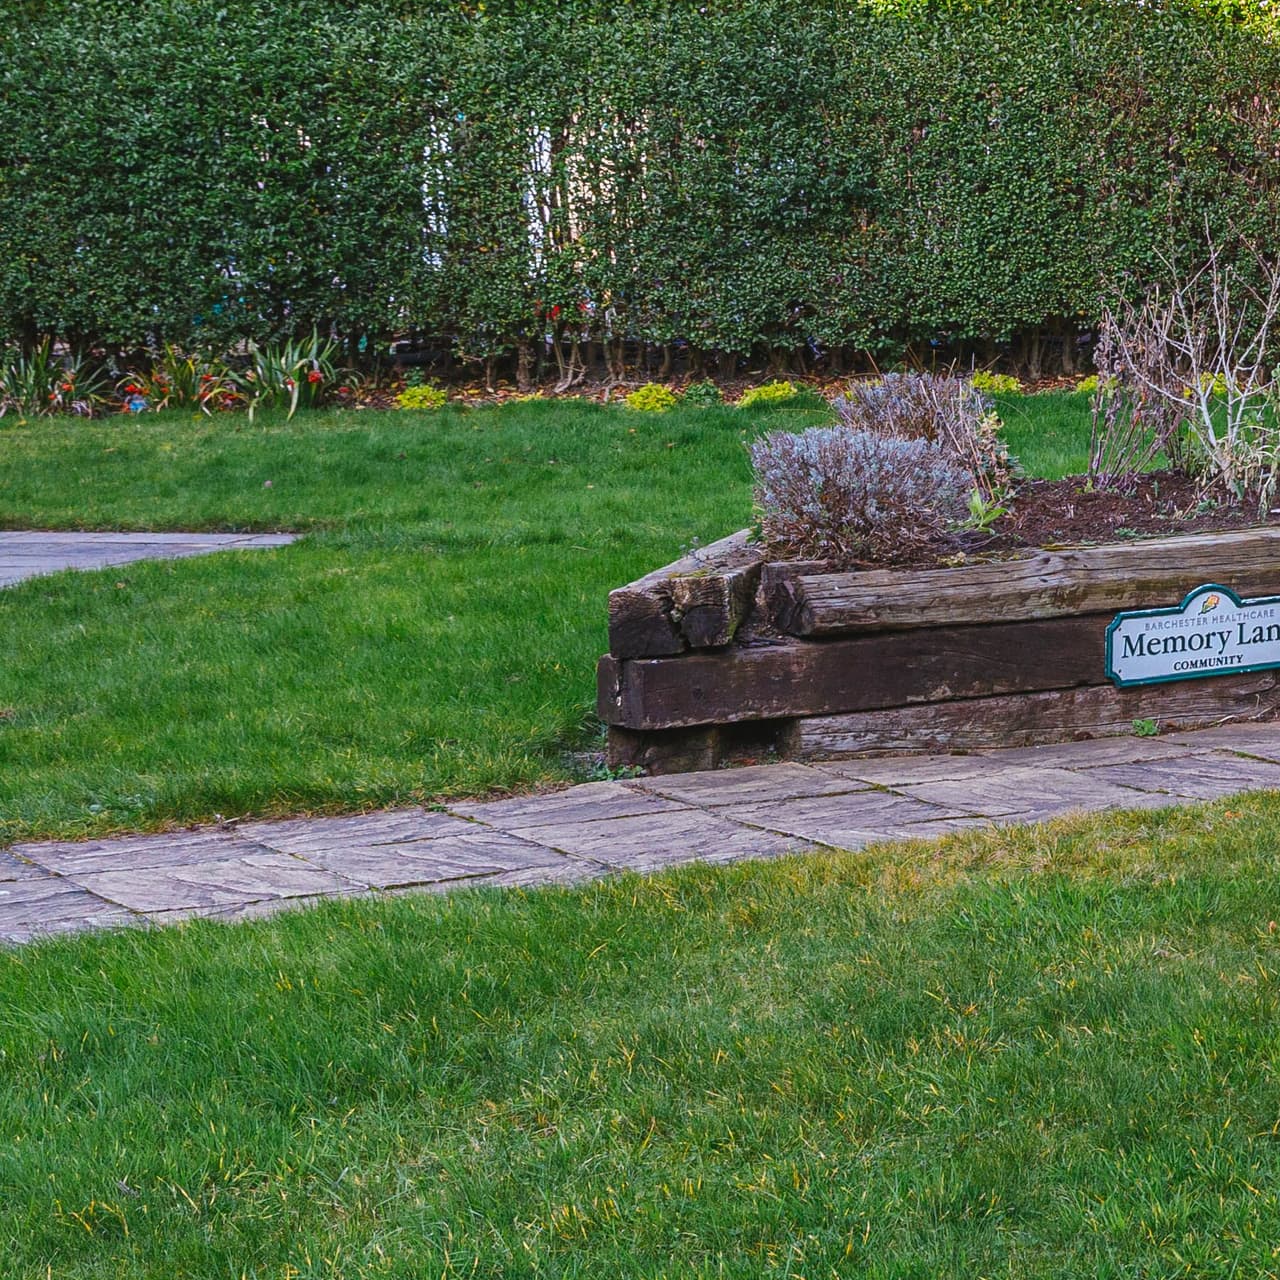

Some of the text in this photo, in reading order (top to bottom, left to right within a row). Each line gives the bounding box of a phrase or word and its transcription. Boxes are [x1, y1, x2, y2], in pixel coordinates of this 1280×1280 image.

[1145, 608, 1275, 631] BARCHESTER HEALTHCARE
[1121, 630, 1232, 658] Memory
[1173, 654, 1244, 671] COMMUNITY
